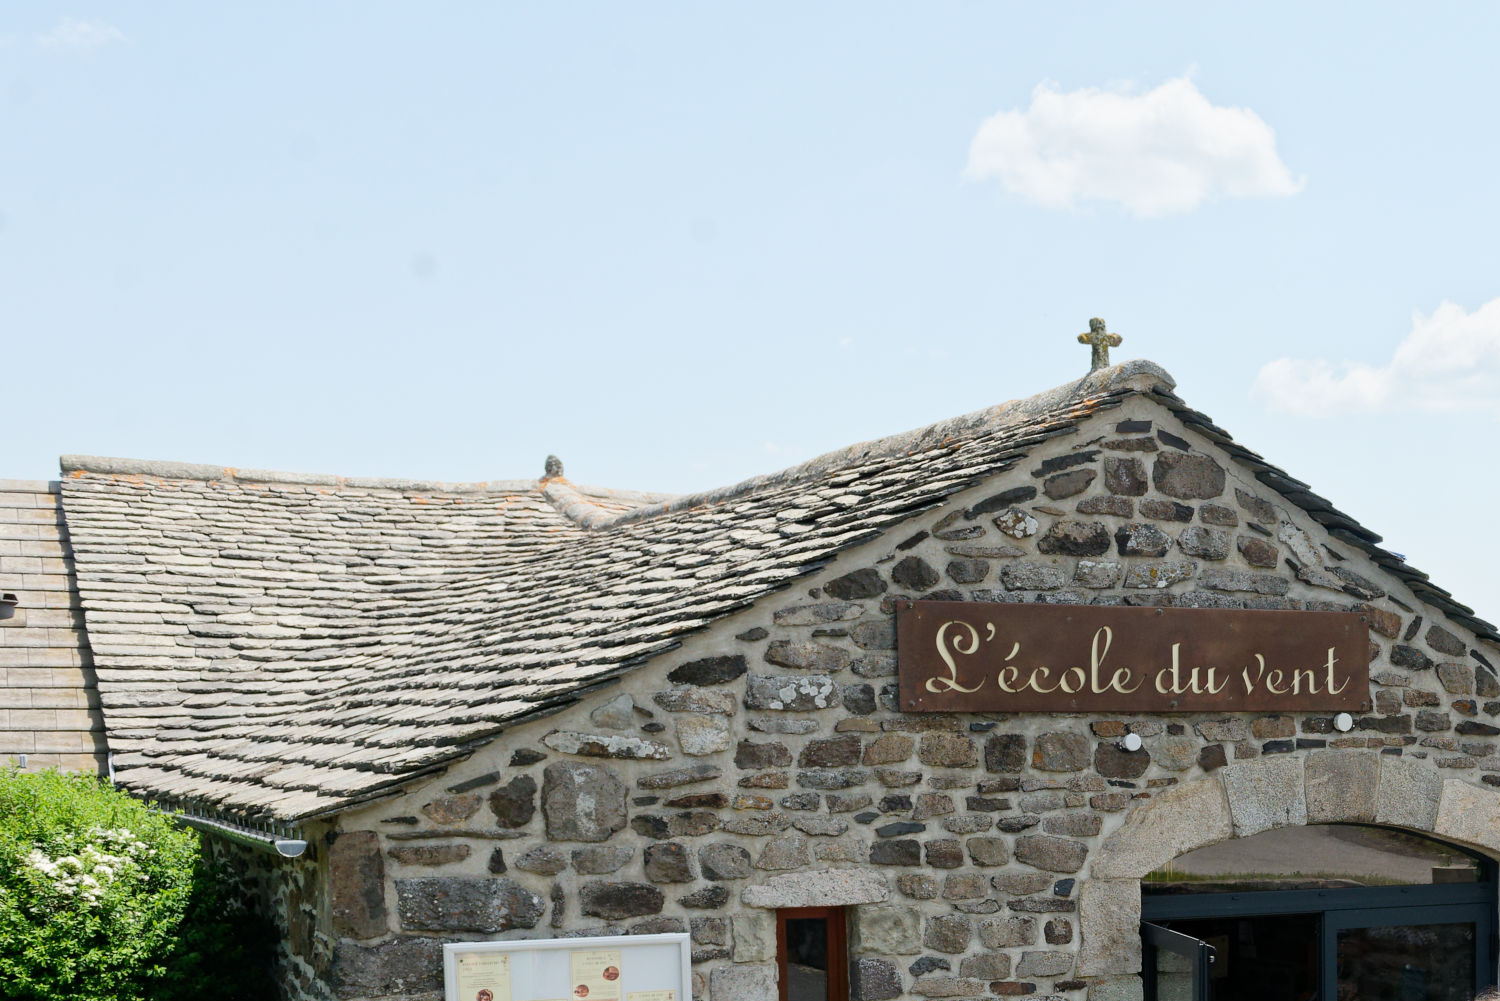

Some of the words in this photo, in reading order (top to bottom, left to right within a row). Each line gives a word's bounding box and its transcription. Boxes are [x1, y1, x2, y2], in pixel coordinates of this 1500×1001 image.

[925, 620, 1146, 694] L'école
[1155, 642, 1230, 695] du
[1242, 646, 1350, 695] vent
